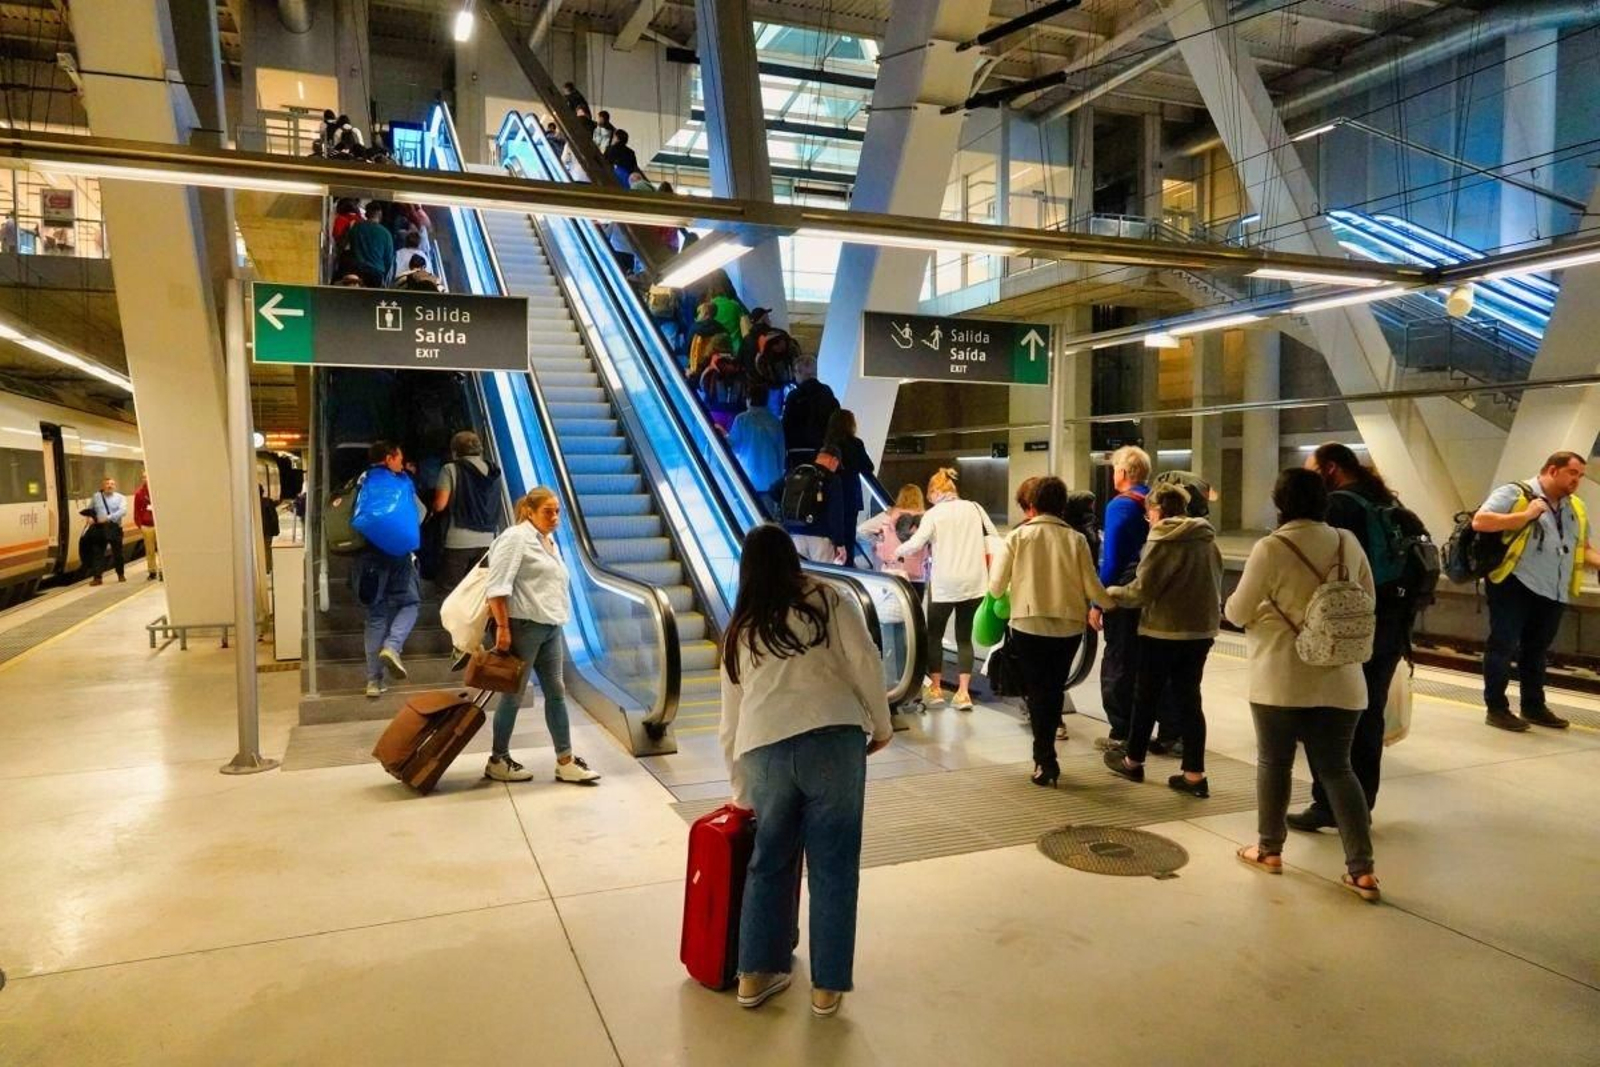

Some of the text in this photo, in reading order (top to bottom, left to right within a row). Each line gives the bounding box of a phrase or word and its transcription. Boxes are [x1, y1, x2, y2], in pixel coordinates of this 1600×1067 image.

[415, 305, 471, 323] Salida
[415, 327, 467, 344] Saída
[951, 328, 990, 344] Salida
[415, 347, 440, 358] EXIT
[950, 347, 987, 361] Saída
[950, 364, 968, 373] EXIT
